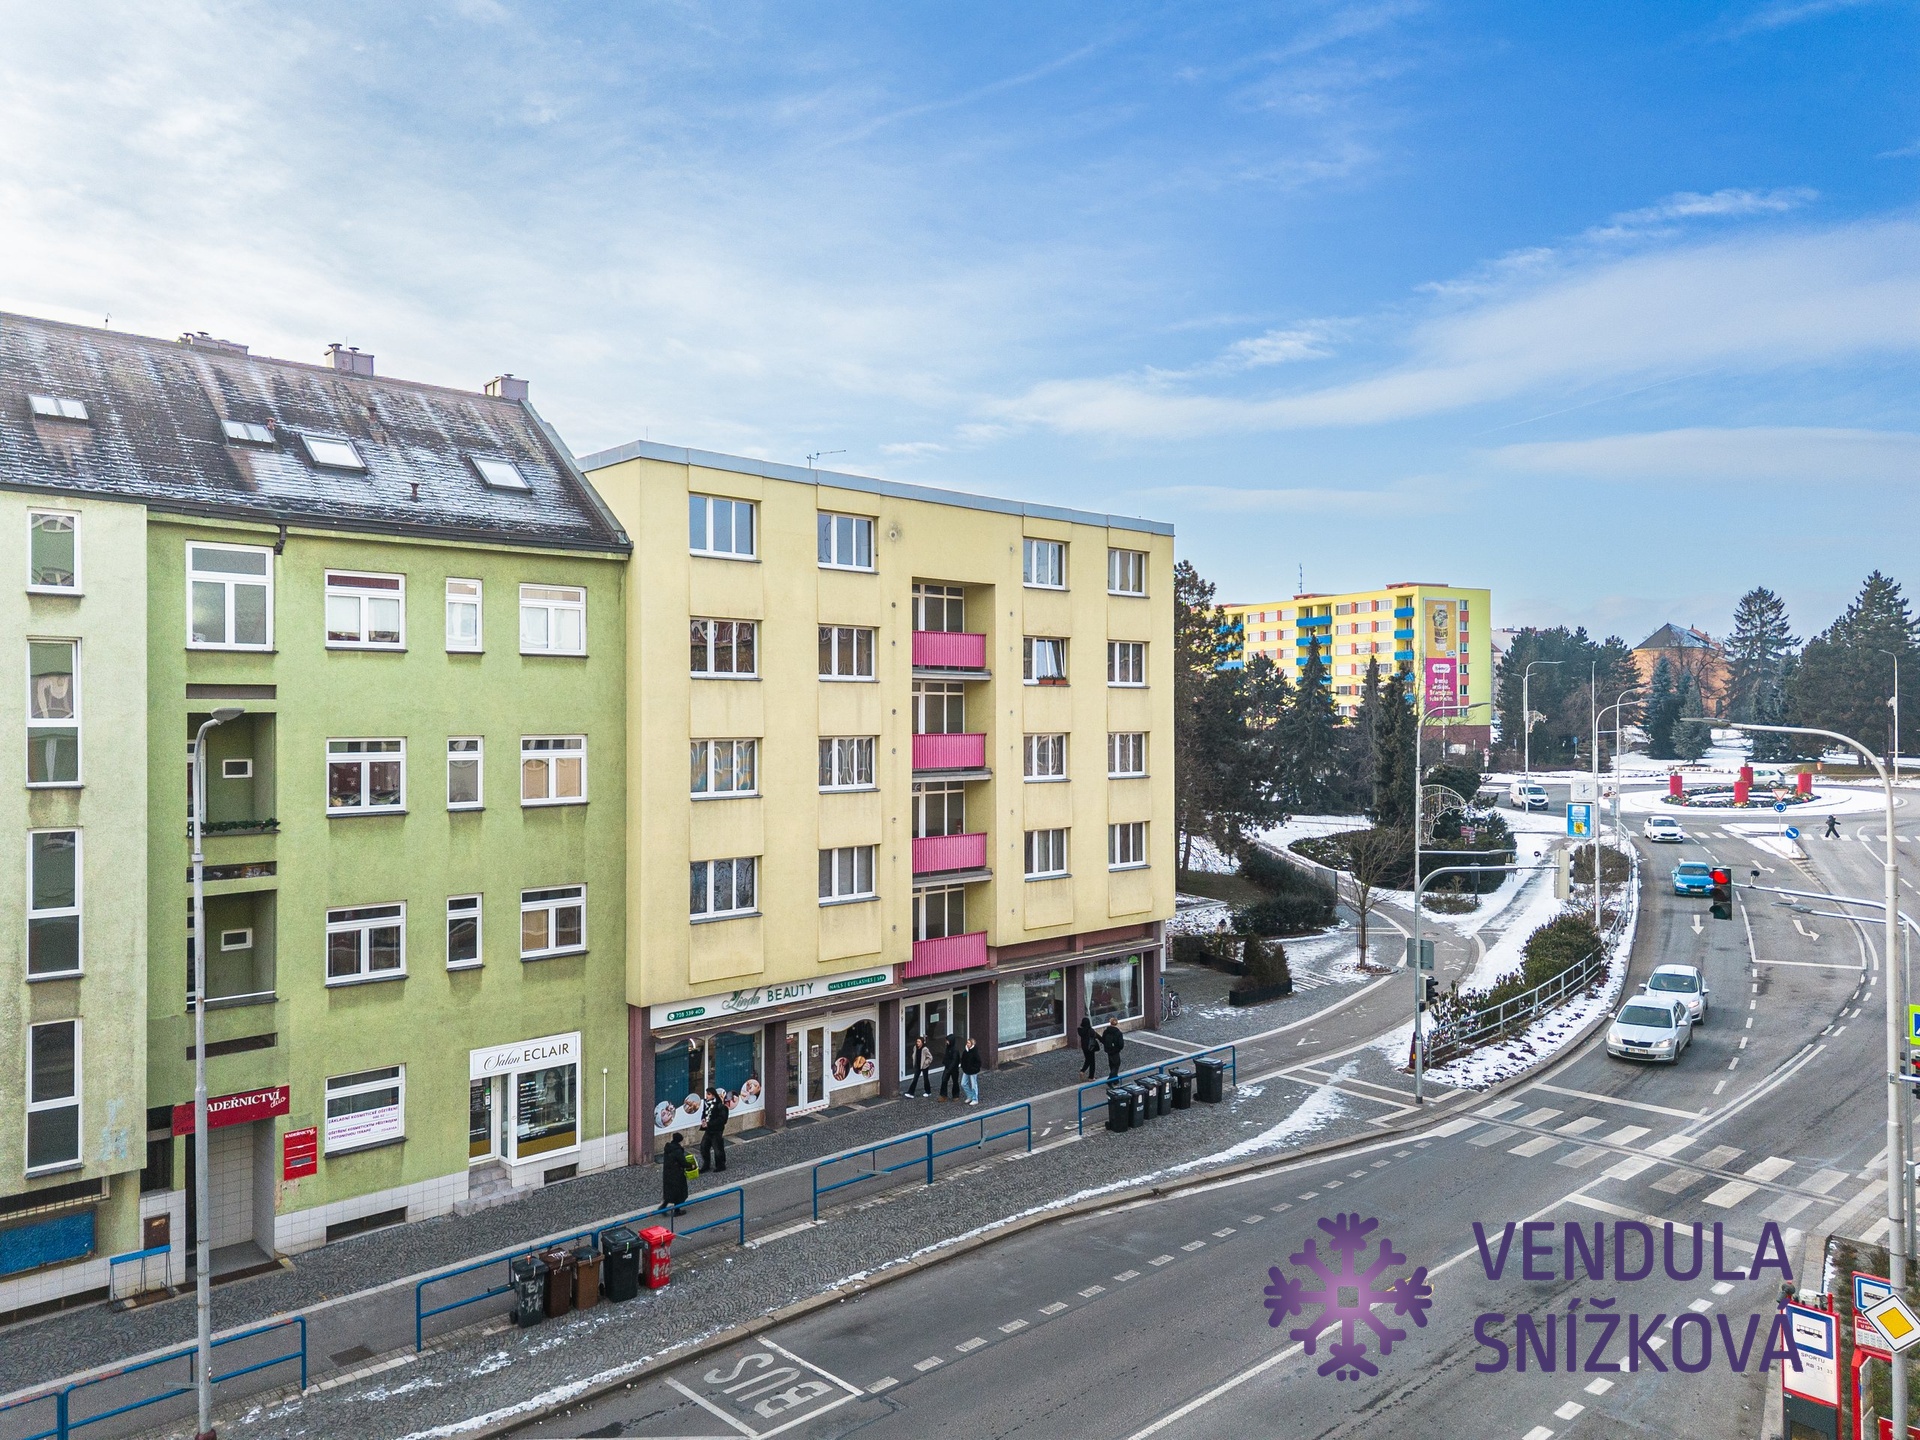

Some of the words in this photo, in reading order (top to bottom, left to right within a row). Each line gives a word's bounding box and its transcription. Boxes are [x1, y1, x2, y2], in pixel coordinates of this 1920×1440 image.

[767, 982, 814, 1002] BEAUTY
[483, 1048, 522, 1071] Salon
[524, 1043, 569, 1062] ECLAIR
[207, 1088, 280, 1114] ADEŘNICTVÍ
[1800, 1352, 1825, 1364] SPORTU
[703, 1353, 833, 1419] BUS
